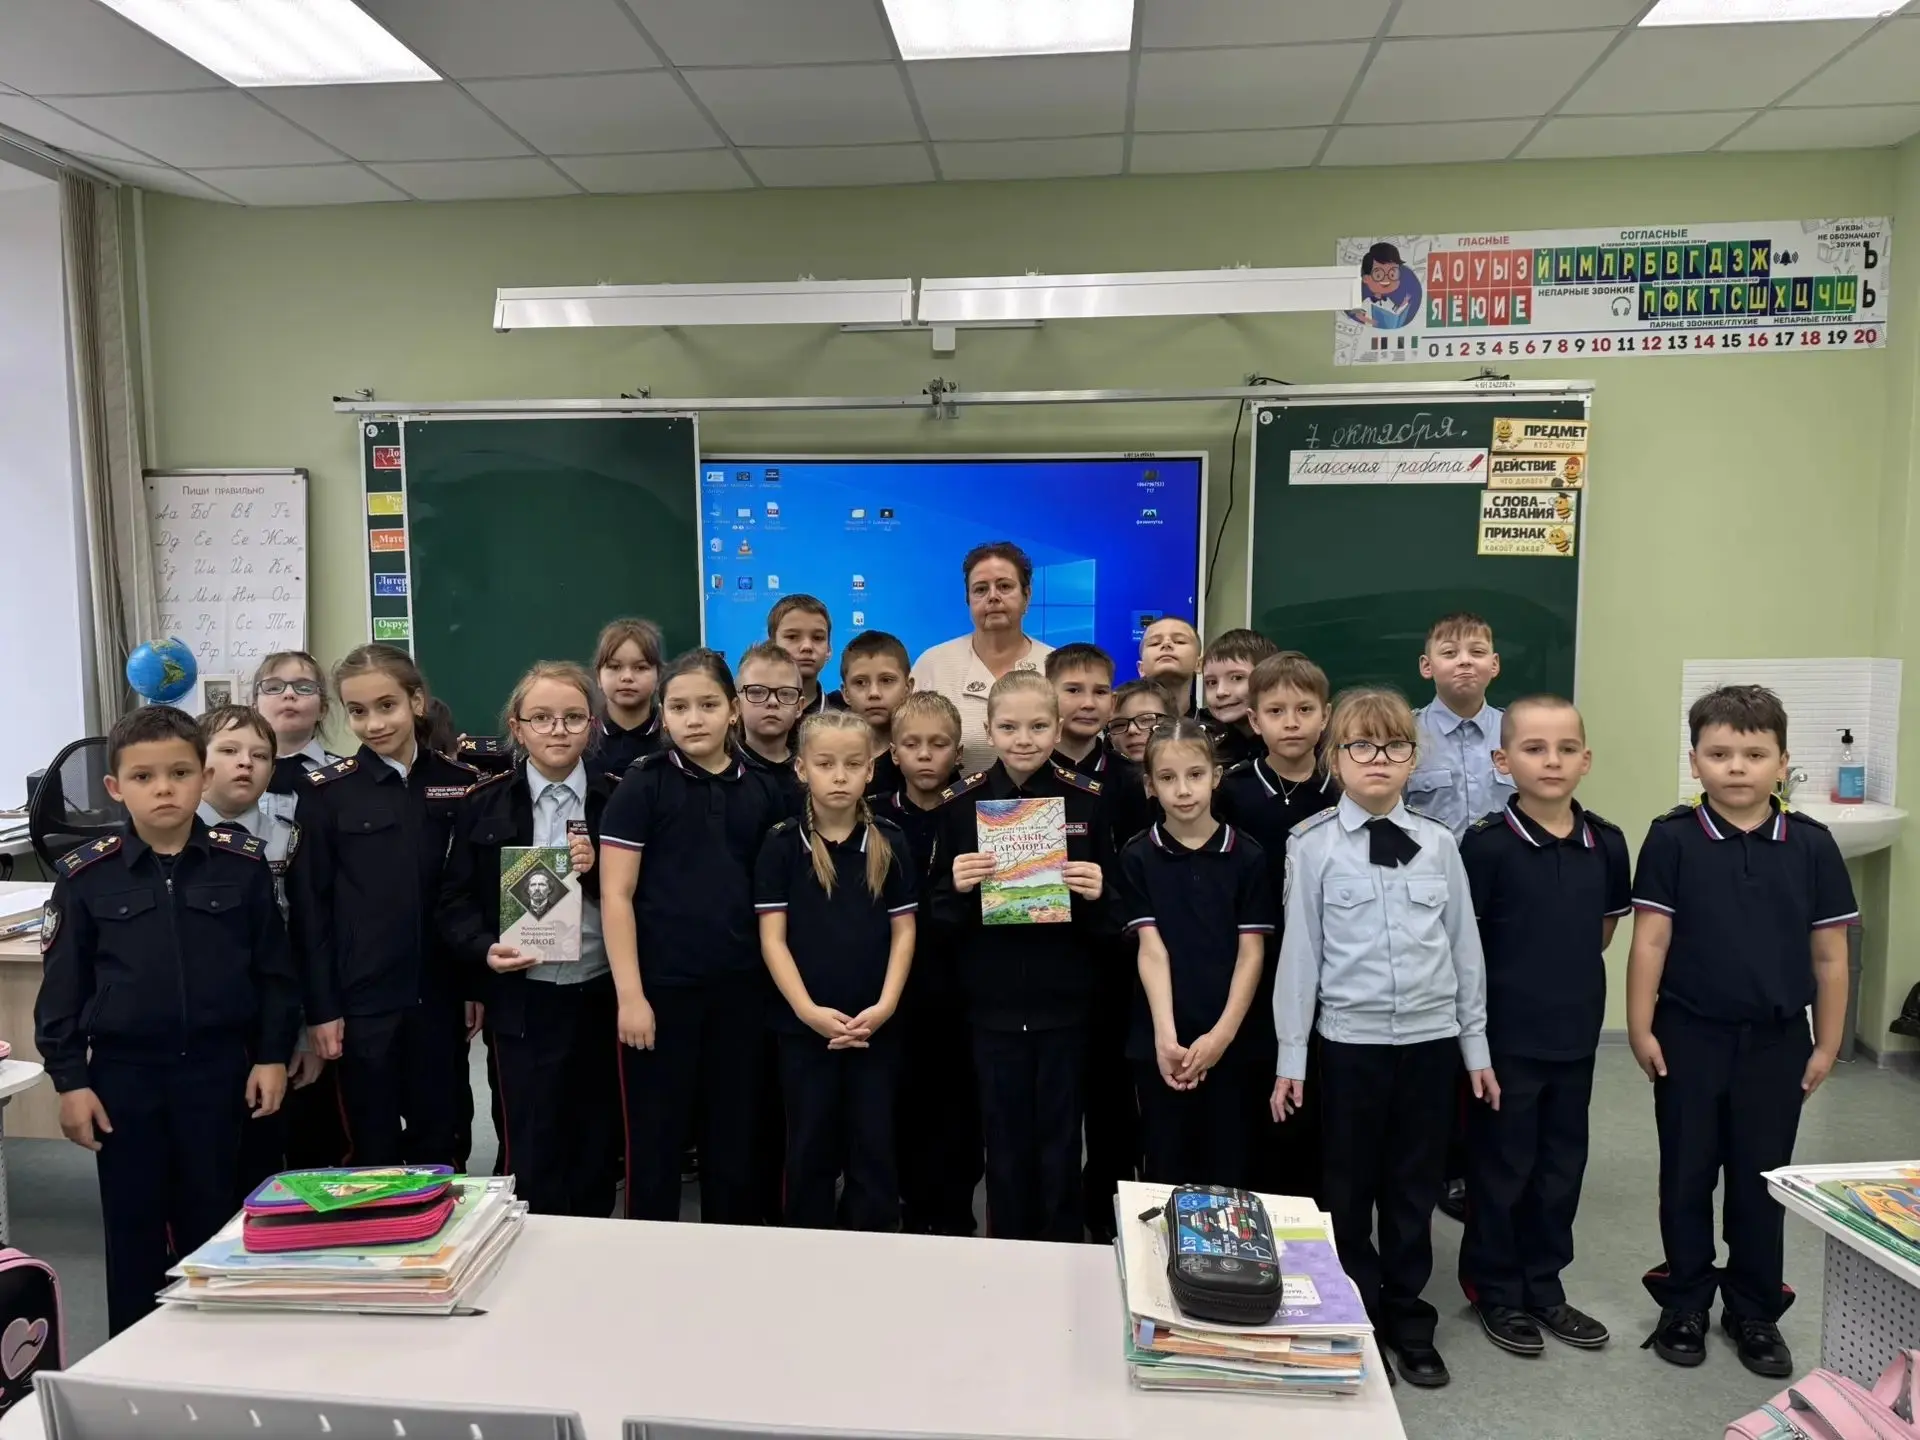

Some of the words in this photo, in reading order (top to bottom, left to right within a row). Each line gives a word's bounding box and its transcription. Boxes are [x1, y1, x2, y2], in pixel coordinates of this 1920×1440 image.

[1458, 236, 1510, 246] ГЛАСНЫЕ
[1620, 229, 1688, 240] СОГЛАСНЫЕ
[1830, 232, 1880, 240] ОБОЗНАЧАЮТ
[1863, 240, 1878, 270] Ъ
[1432, 260, 1444, 282] А
[1453, 258, 1464, 282] О
[1474, 258, 1486, 280] У
[1494, 258, 1508, 280] Ы
[1516, 256, 1528, 280] Э
[1538, 248, 1550, 279] Й
[1559, 255, 1570, 278] Н
[1580, 254, 1593, 278] М
[1601, 254, 1614, 276] Л
[1624, 252, 1634, 276] Р
[1644, 252, 1656, 275] Б
[1666, 251, 1678, 274] В
[1690, 250, 1699, 273] Г
[1709, 248, 1722, 273] Д
[1751, 248, 1768, 270] Ж
[1538, 288, 1590, 297] НЕПАРНЫЕ
[1592, 286, 1635, 296] ЗВОНКИЕ
[1643, 290, 1654, 314] П
[1664, 290, 1678, 312] Ф
[1686, 288, 1699, 312] К
[1710, 288, 1721, 311] Т
[1730, 287, 1742, 310] С
[1750, 286, 1768, 310] Ш
[1774, 285, 1787, 309] Х
[1795, 283, 1808, 309] Ц
[1818, 284, 1831, 307] Ч
[1836, 282, 1856, 308] Щ
[1862, 280, 1876, 308] Ь
[1431, 298, 1443, 320] Я
[1452, 295, 1463, 322] Ё
[1471, 296, 1487, 320] Ю
[1494, 296, 1506, 318] И
[1516, 295, 1526, 318] Е
[1650, 320, 1684, 328] ПАРНЫЕ
[1686, 318, 1759, 328] ЗВОНКИЕ/ГЛУХИЕ
[1774, 316, 1820, 324] НЕПАРНЫЕ
[1822, 314, 1853, 323] ГЛУХИЕ
[1428, 343, 1440, 358] 0
[1446, 342, 1454, 356] 1
[1460, 342, 1470, 356] 2
[1476, 342, 1486, 356] 3
[1492, 341, 1504, 356] 4
[1509, 340, 1519, 355] 5
[1526, 340, 1536, 354] 6
[1542, 340, 1552, 354] 7
[1558, 339, 1568, 353] 8
[1574, 338, 1586, 352] 9
[1592, 338, 1612, 352] 10
[1618, 337, 1636, 351] 11
[1642, 336, 1662, 350] 12
[1668, 336, 1688, 350] 13
[1694, 334, 1715, 348] 14
[1722, 334, 1742, 348] 15
[1748, 333, 1768, 347] 16
[1775, 332, 1796, 346] 17
[1800, 331, 1821, 345] 18
[1828, 330, 1848, 344] 19
[1854, 329, 1878, 344] 20
[1305, 423, 1320, 449] 7
[1524, 425, 1588, 438] ПРЕДМЕТ
[1297, 453, 1380, 476] Классная
[1390, 452, 1465, 482] работа
[1492, 458, 1556, 473] ДЕЙСТВИЕ
[1484, 507, 1554, 520] НАЗВАНИЯ
[1484, 527, 1546, 539] ПРИЗНАК
[520, 938, 555, 946] ЖАКОВ
